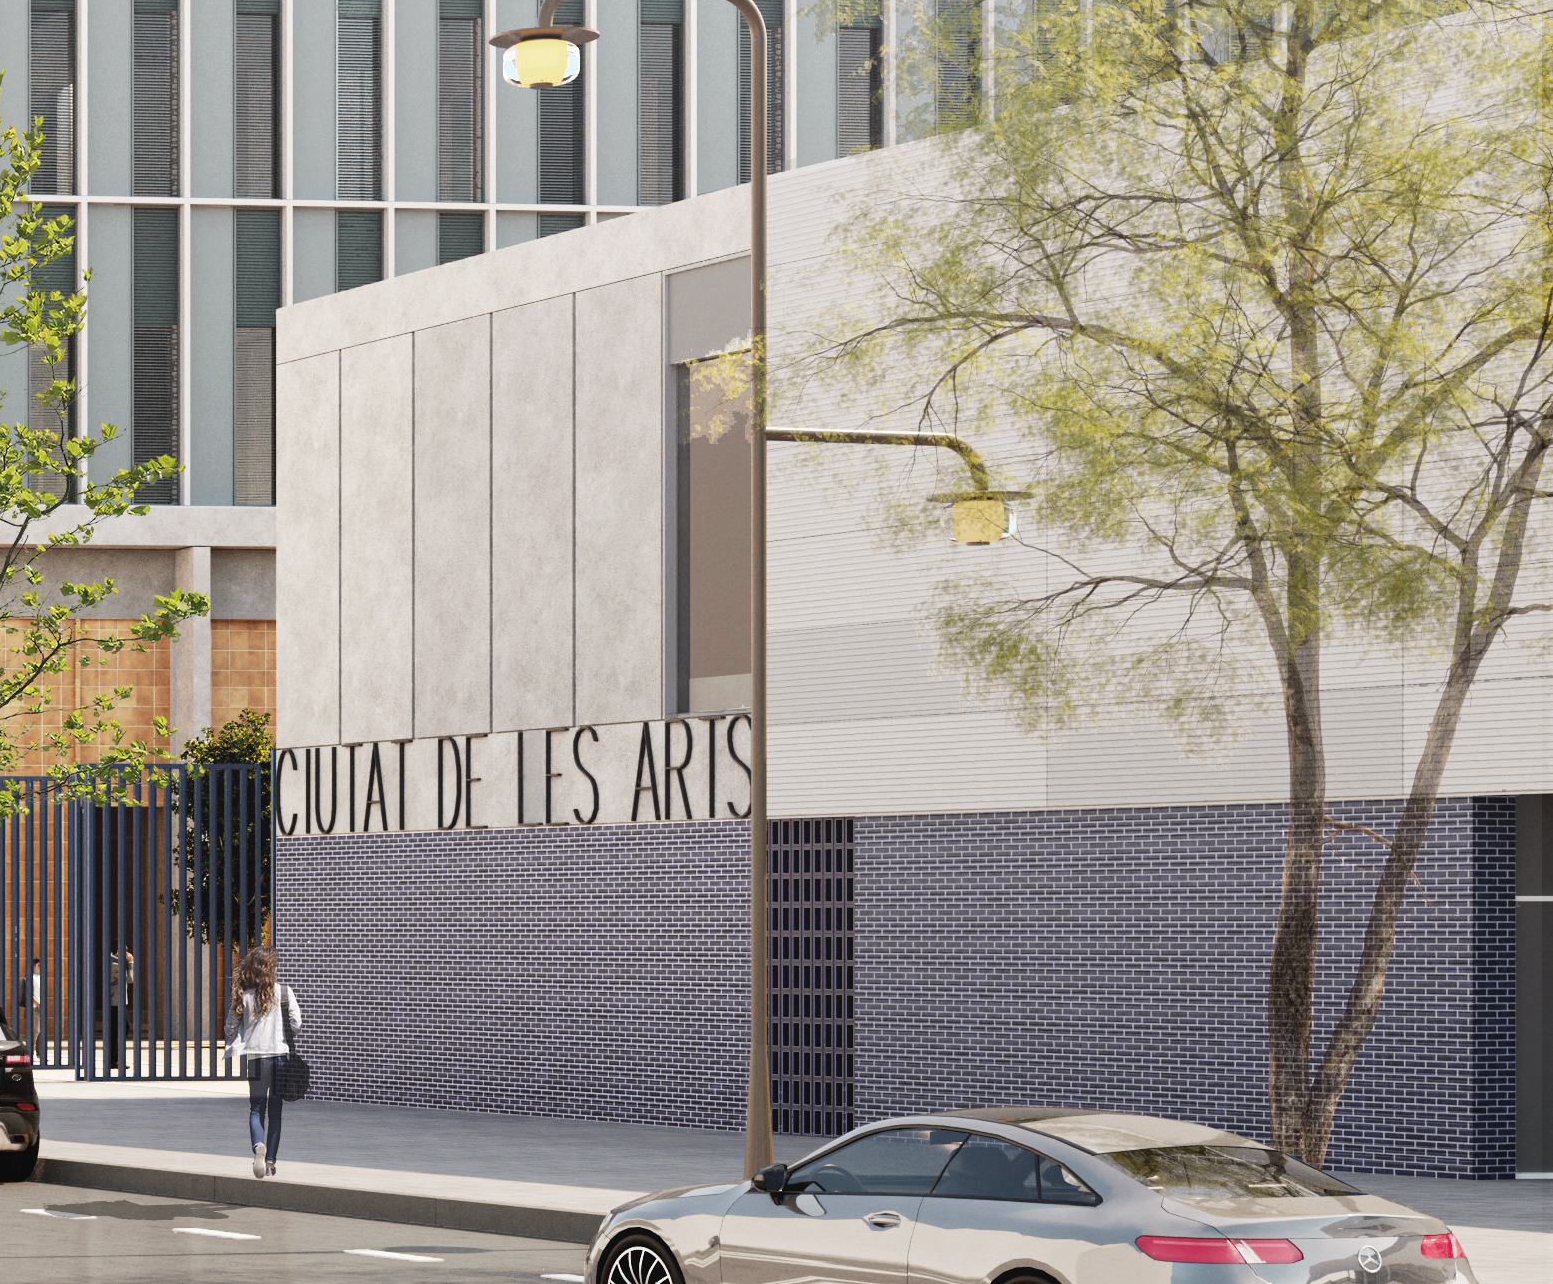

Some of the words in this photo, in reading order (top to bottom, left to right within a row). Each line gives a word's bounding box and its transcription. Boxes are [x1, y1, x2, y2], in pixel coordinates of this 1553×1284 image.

[276, 739, 413, 836] CIUTAT
[438, 733, 488, 830] DE
[517, 725, 600, 826] LES
[630, 714, 752, 821] ARTS
